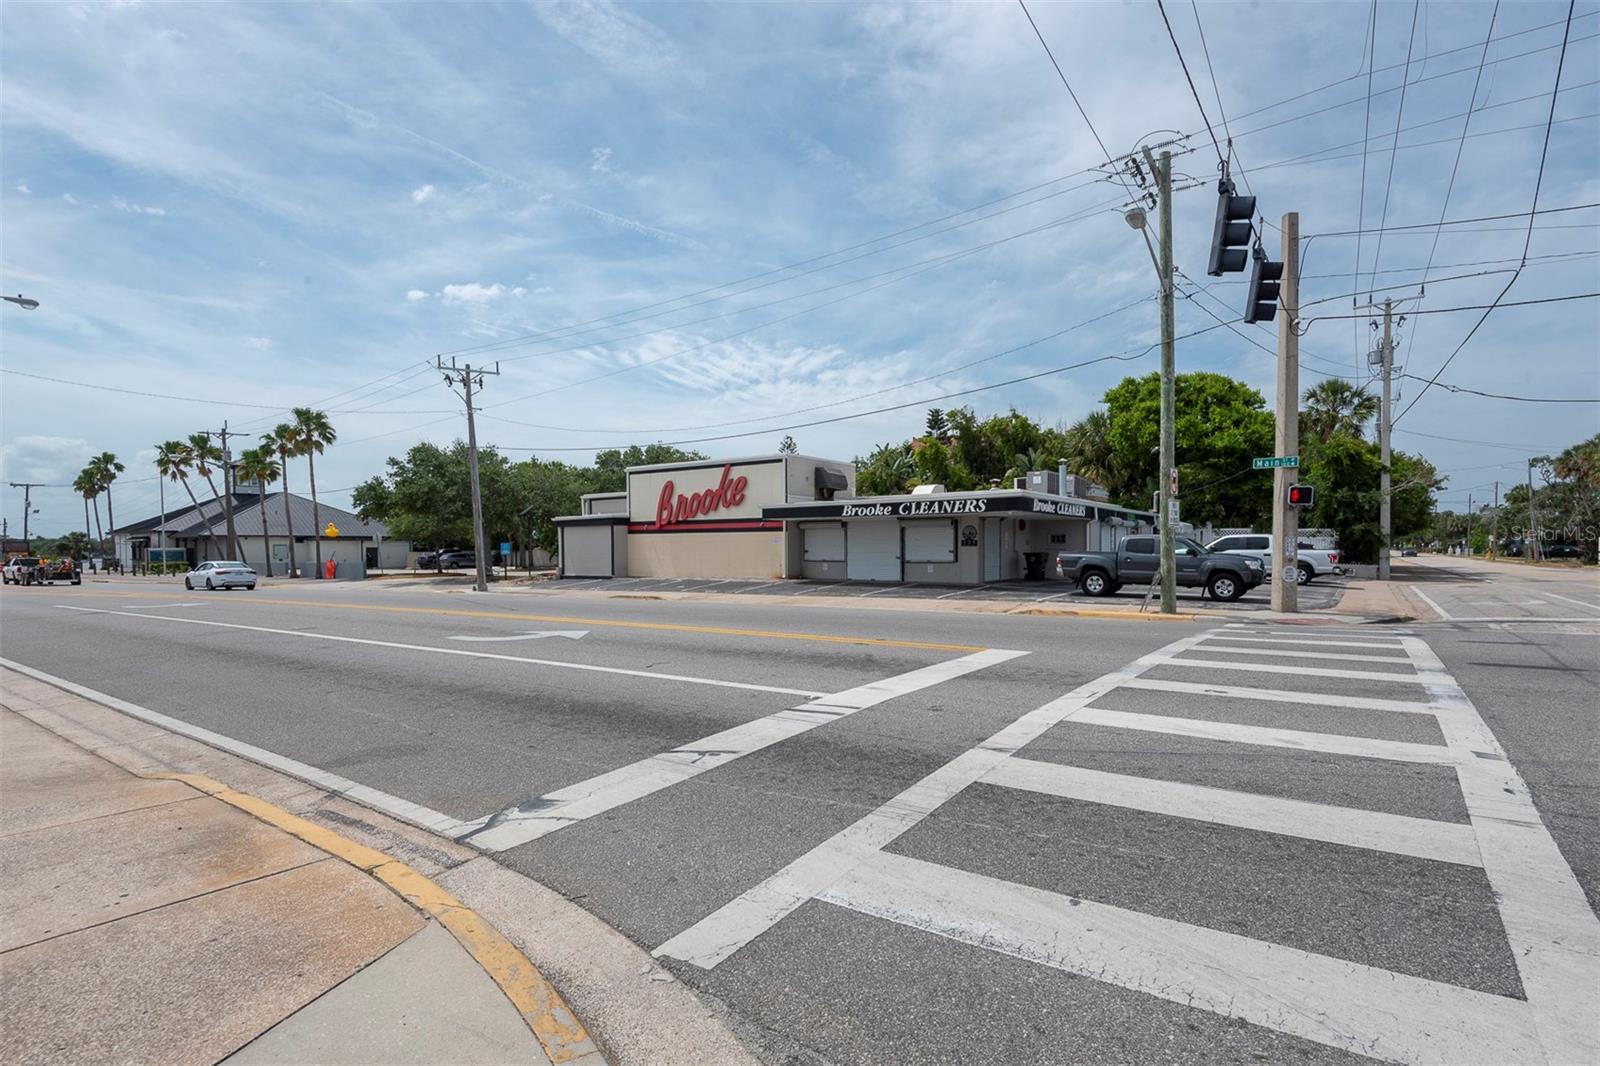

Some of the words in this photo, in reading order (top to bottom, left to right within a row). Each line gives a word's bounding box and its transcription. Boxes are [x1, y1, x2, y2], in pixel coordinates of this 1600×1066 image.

[1256, 459, 1280, 468] Main
[655, 463, 748, 529] Brooke
[842, 503, 892, 517] Brooke
[898, 499, 987, 515] CLEANERS
[1033, 499, 1056, 513] Brooke
[1056, 502, 1086, 517] CLEANERS
